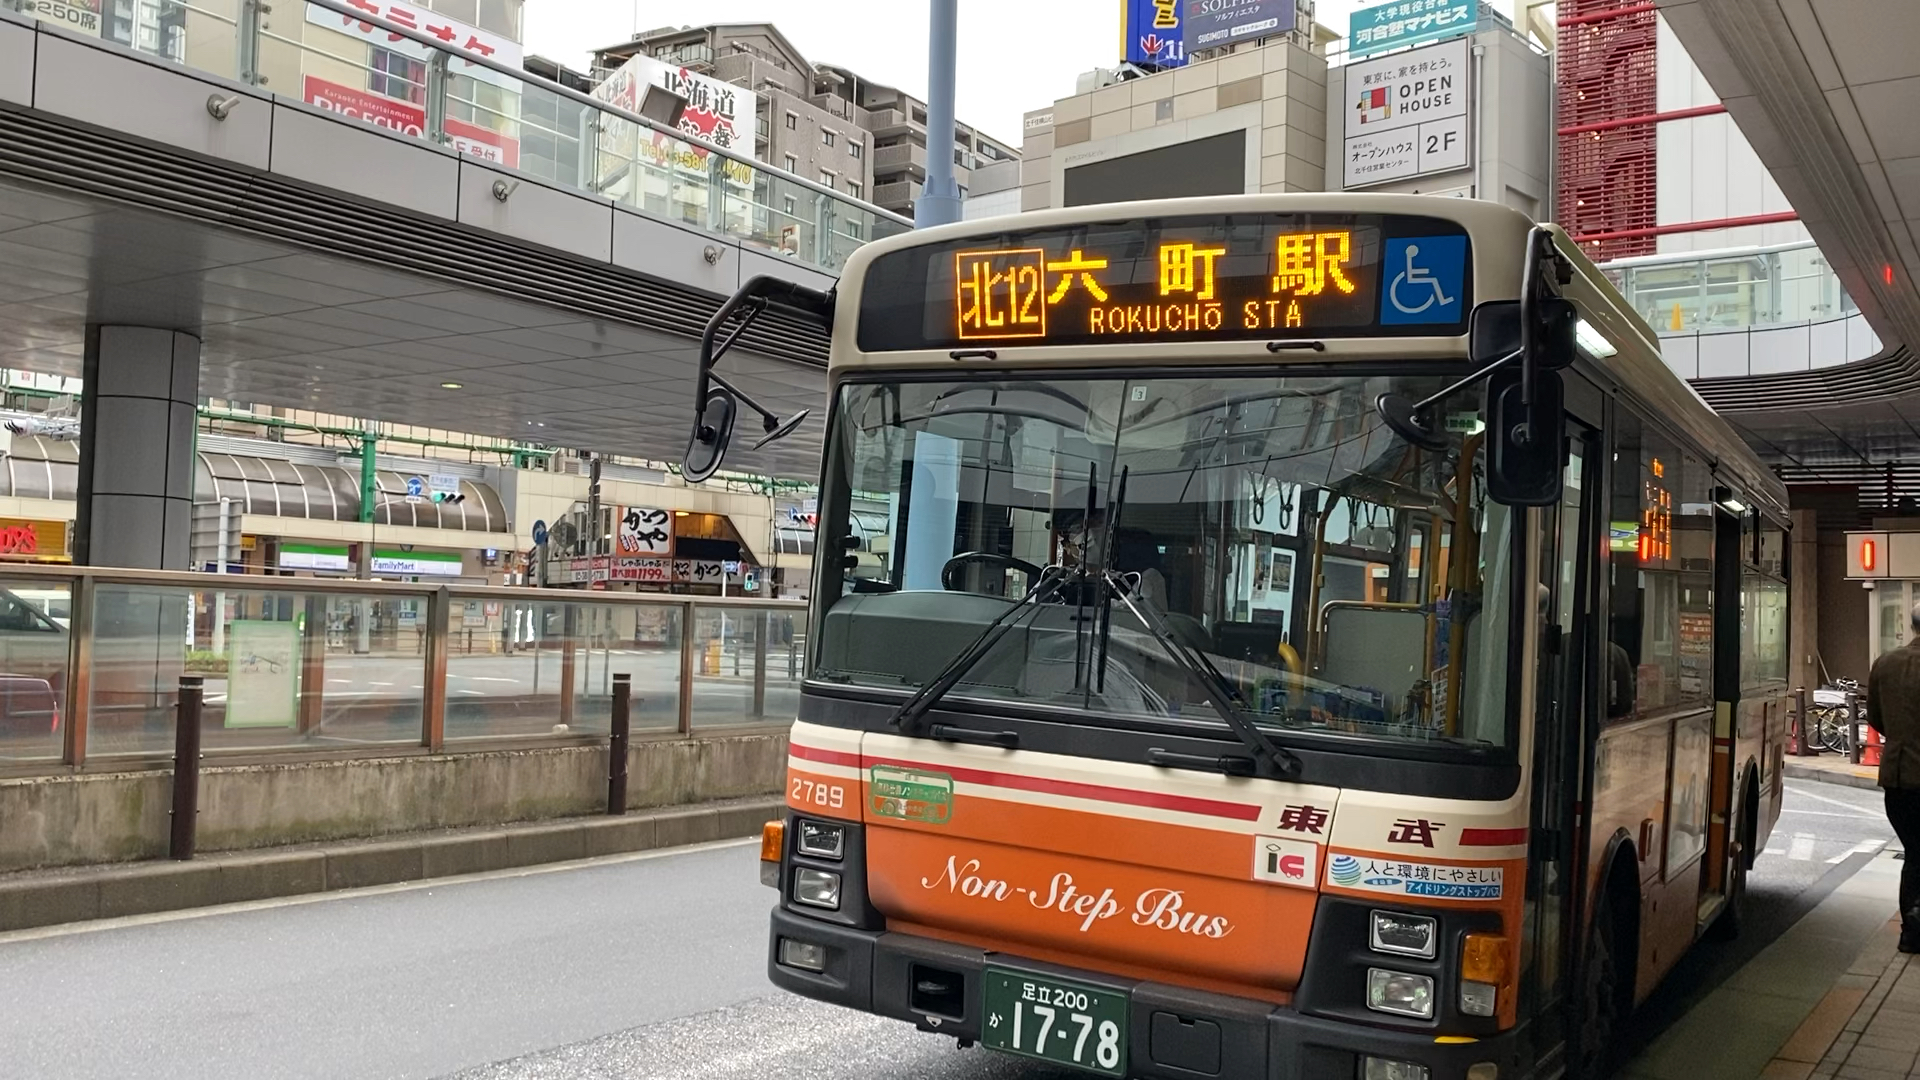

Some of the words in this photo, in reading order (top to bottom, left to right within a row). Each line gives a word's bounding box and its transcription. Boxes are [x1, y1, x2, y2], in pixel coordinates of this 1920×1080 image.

[1198, 28, 1229, 44] SUGIMOTO
[1356, 5, 1468, 45] 河合塾マナビス
[1363, 58, 1452, 86] 東京に、家を持とう。
[664, 70, 736, 121] 北海道
[1400, 75, 1452, 98] OPEN
[324, 88, 357, 104] Karaoke
[359, 98, 415, 121] Entertainment
[1400, 93, 1452, 114] HOUSE
[1352, 142, 1413, 162] オープンハウス
[1426, 131, 1457, 155] 2F
[961, 262, 1039, 328] 北12
[1048, 232, 1355, 304] 六町駅
[1245, 300, 1302, 328] STA
[622, 507, 669, 551] かつや
[373, 560, 415, 571] FamilyMart
[621, 559, 662, 567] しゃぶしゃぶ
[792, 778, 844, 808] 2789
[1277, 804, 1446, 848] 東武
[1365, 860, 1501, 883] 人と環境にやさしい
[921, 855, 1125, 932] Non-Step
[1131, 887, 1235, 939] Bus
[1406, 882, 1499, 898] アイドリングストップバス
[1021, 982, 1088, 1011] 足立200
[989, 1011, 1004, 1029] か
[1012, 1001, 1120, 1069] 17-78
